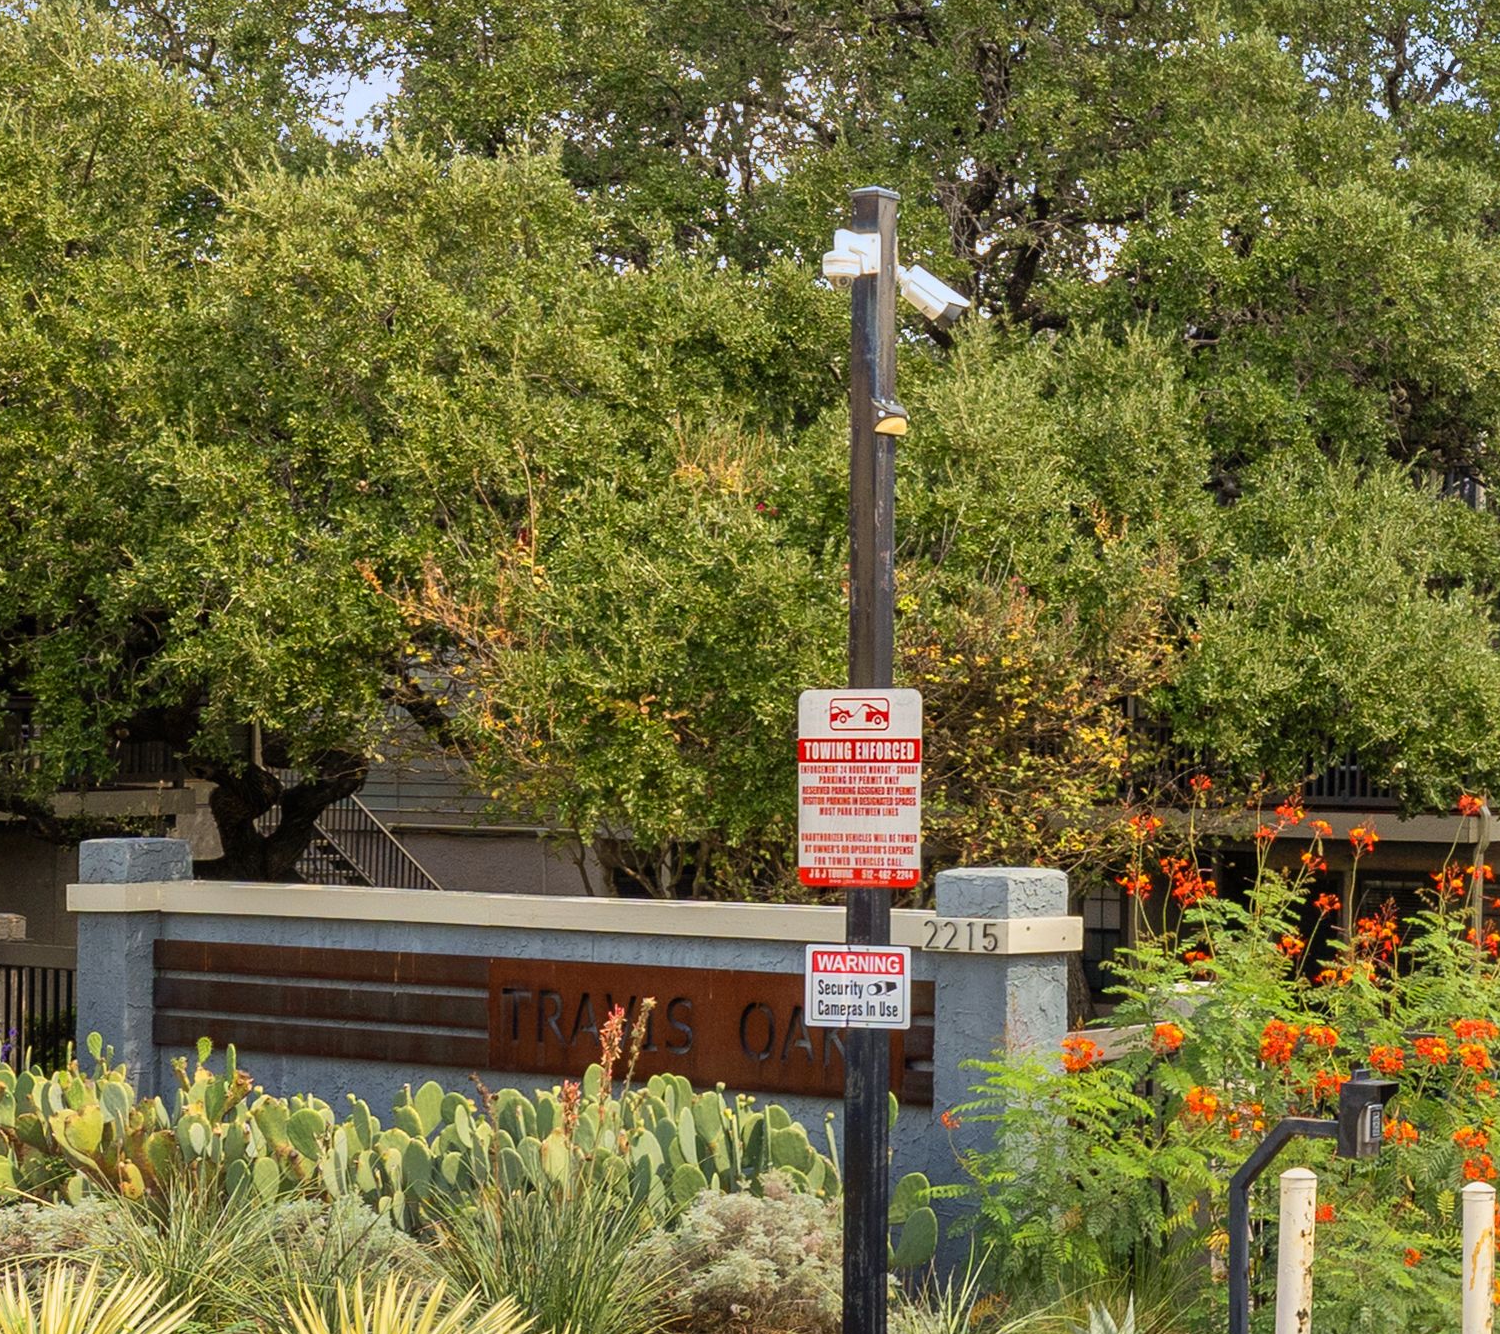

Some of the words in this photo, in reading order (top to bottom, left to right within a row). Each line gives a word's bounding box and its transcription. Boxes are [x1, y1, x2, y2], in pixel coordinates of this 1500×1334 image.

[804, 742, 852, 760] TOWING
[855, 742, 915, 760] ENFORCED
[800, 765, 838, 774] ENFORCEMENT
[849, 765, 866, 774] HOURS
[869, 765, 891, 774] MONDAY
[897, 765, 918, 774] SUNDAY
[819, 776, 847, 784] PARKING
[849, 776, 857, 784] BY
[859, 776, 882, 784] PERMIT
[884, 776, 899, 784] ONLY
[802, 786, 829, 795] RESERVED
[832, 786, 855, 795] PARKING
[858, 786, 884, 795] ASSIGNED
[887, 786, 894, 795] BY
[895, 786, 917, 795] PERMIT
[802, 796, 825, 805] VISITOR
[827, 796, 851, 805] PARKING
[852, 796, 858, 805] IN
[859, 797, 893, 806] DESIGNATED
[895, 797, 916, 806] SPACES
[819, 807, 836, 815] MUST
[837, 807, 852, 815] PARK
[854, 807, 880, 816] BETWEEN
[882, 807, 899, 816] LINES
[801, 833, 843, 842] UNAUTHORIZED
[845, 833, 871, 842] VEHICLES
[873, 833, 887, 842] WILL
[889, 834, 896, 843] BE
[897, 834, 917, 843] TOWED
[804, 845, 812, 853] AT
[813, 845, 840, 854] OWNER'S
[841, 845, 850, 854] OR
[851, 845, 886, 854] OPERATOR'S
[888, 846, 914, 855] EXPENSE
[814, 856, 826, 865] FOR
[828, 856, 850, 865] TOWED
[855, 857, 884, 866] VEHICLES
[924, 920, 999, 952] 2215
[817, 954, 900, 973] WARNING
[818, 979, 864, 999] Security
[818, 1000, 863, 1017] Cameras
[866, 1001, 876, 1017] In
[879, 1001, 898, 1017] Use
